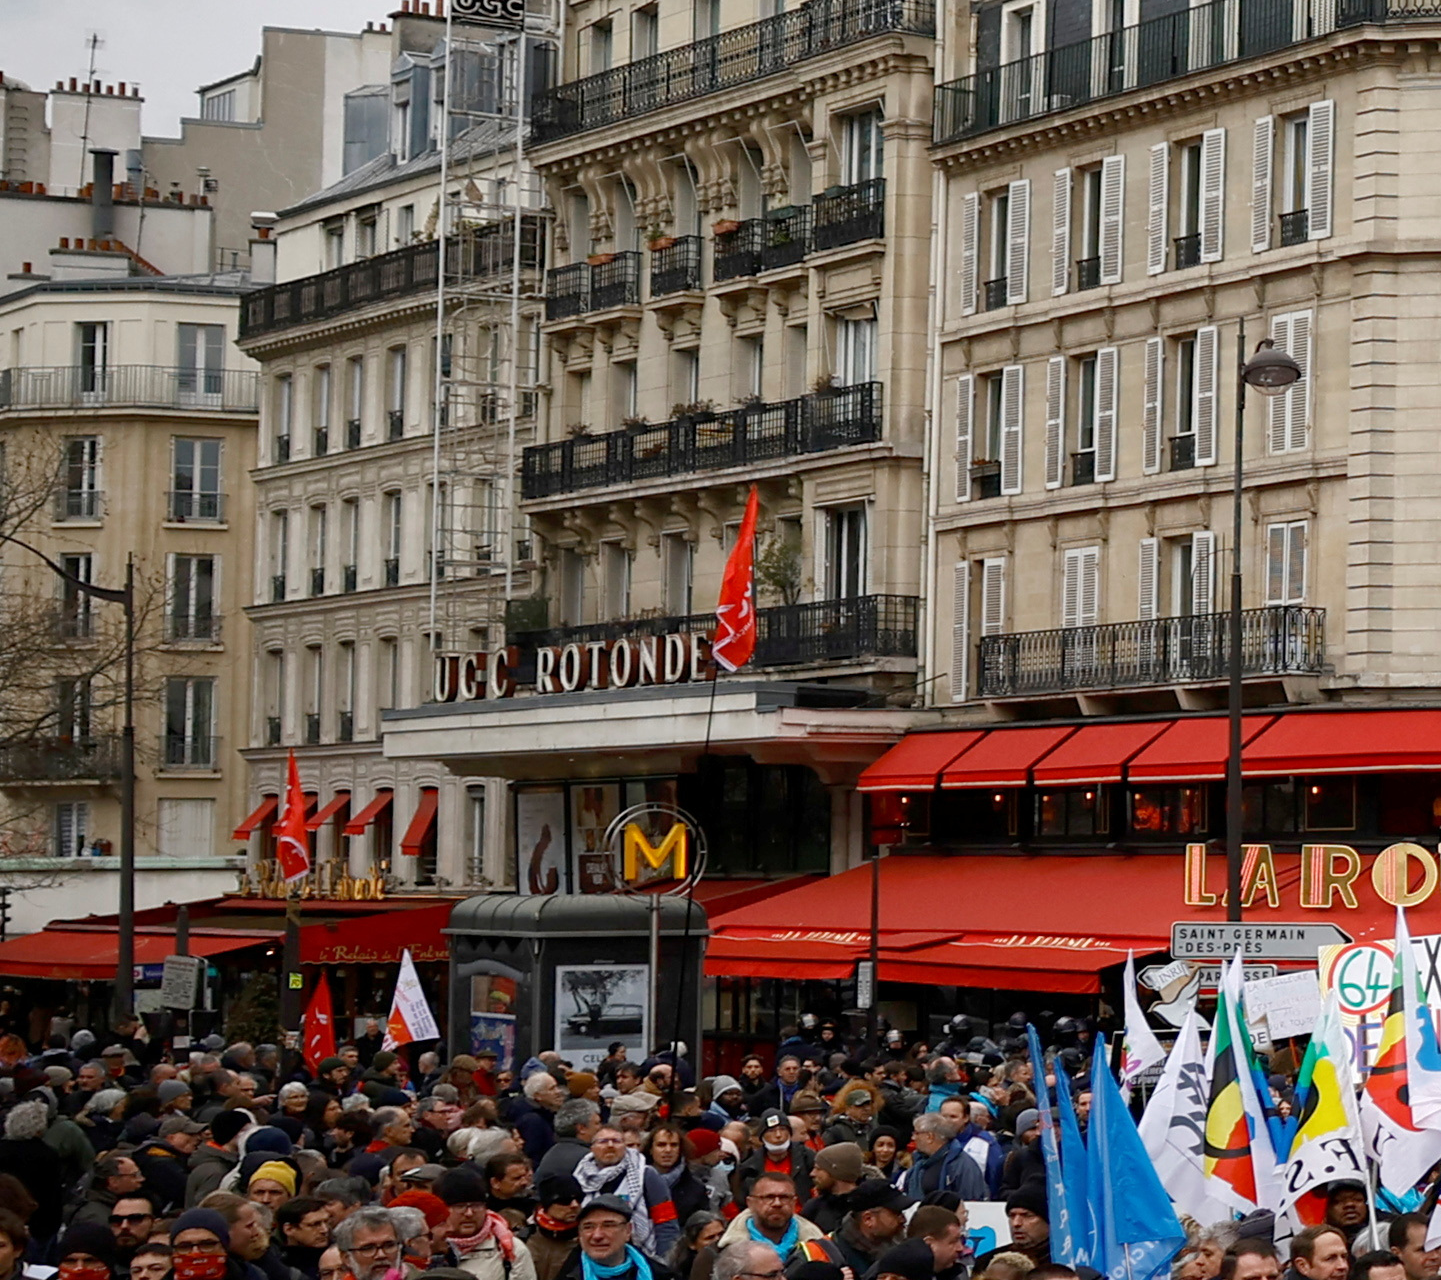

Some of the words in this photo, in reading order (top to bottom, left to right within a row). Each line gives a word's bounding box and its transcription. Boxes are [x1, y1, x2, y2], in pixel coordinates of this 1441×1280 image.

[434, 650, 510, 702] UGC
[536, 632, 710, 694] ROTONDE
[624, 822, 686, 880] M
[333, 945, 377, 960] Relais
[1179, 929, 1225, 939] SAINT
[1233, 929, 1305, 940] GERMAIN
[1338, 949, 1390, 1007] 64
